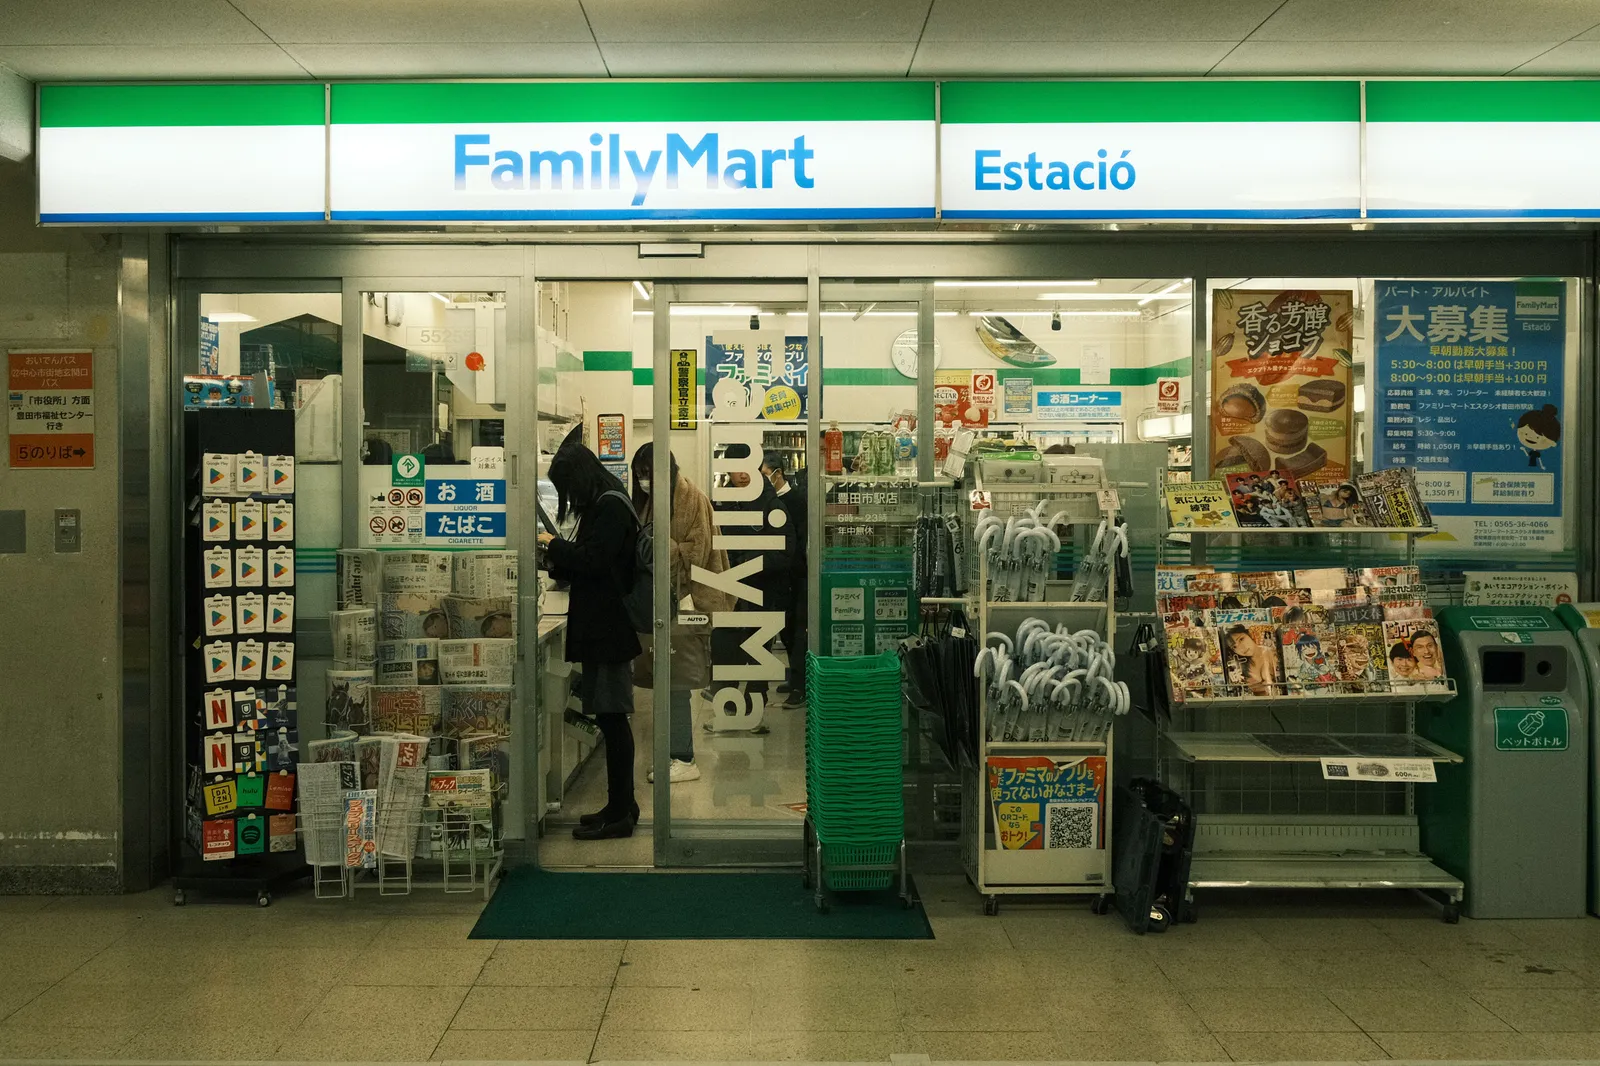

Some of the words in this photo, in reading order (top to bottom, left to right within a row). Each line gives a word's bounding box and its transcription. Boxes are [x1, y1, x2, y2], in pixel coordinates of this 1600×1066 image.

[454, 133, 815, 207] FamilyMart
[975, 149, 1136, 190] Estació
[1385, 286, 1490, 298] パート・アルバイト
[1516, 301, 1558, 310] FamilyMart
[1239, 302, 1328, 333] 香る芳醇
[1385, 305, 1510, 343] 大募集
[1522, 322, 1551, 331] Estació
[1247, 331, 1321, 357] ショコラ
[25, 356, 77, 365] おいでんバス
[41, 379, 59, 387] バス
[71, 395, 91, 405] 方面
[769, 390, 787, 402] 会員
[1050, 393, 1108, 404] お酒コーナー
[16, 411, 93, 420] 豊田市福祉センター
[46, 421, 64, 431] 行き
[1165, 484, 1222, 492] PRESIDENT
[838, 492, 898, 504] 豊田市駅店
[1174, 495, 1222, 504] 気にしない
[1190, 504, 1210, 512] 練習
[438, 515, 494, 534] たばこ
[838, 526, 874, 535] 年中無休
[834, 607, 861, 615] FamiPay
[1333, 608, 1382, 621] 週刊文春
[1502, 737, 1562, 746] ペットボトル
[1001, 831, 1028, 842] おトク!
